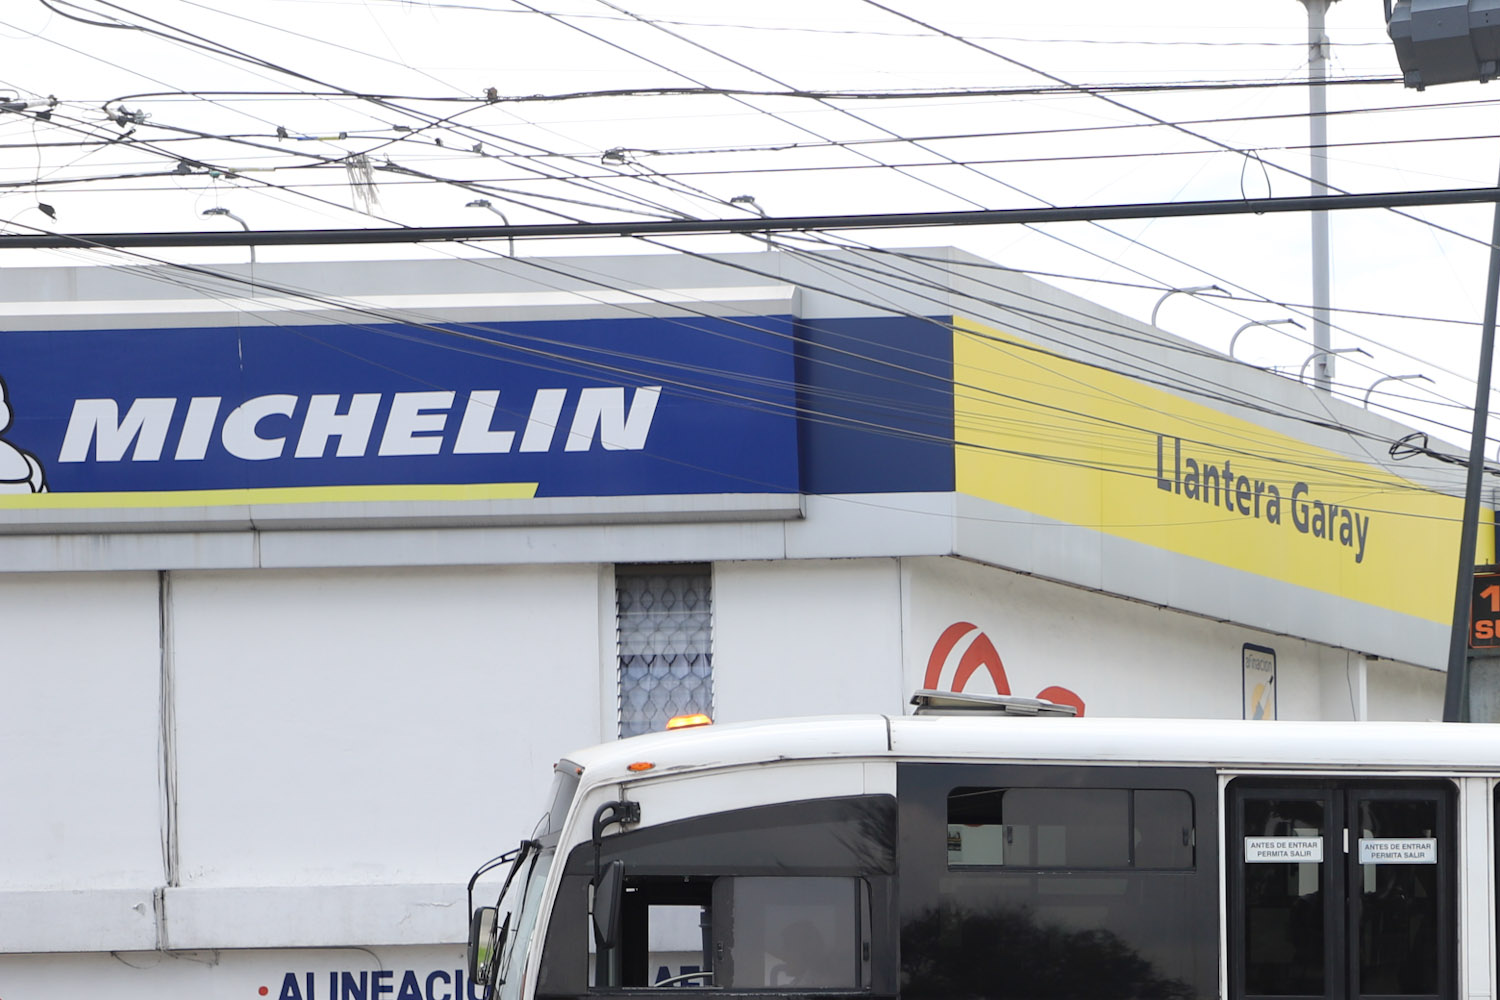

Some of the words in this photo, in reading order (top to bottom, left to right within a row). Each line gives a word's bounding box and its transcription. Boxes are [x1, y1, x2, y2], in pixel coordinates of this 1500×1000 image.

[58, 386, 662, 463] MICHELIN
[1157, 435, 1281, 525] Llantera
[1291, 481, 1369, 564] Garay
[1251, 841, 1275, 849] ANTES
[1276, 841, 1286, 849] DE
[1288, 841, 1318, 849] ENTRAR
